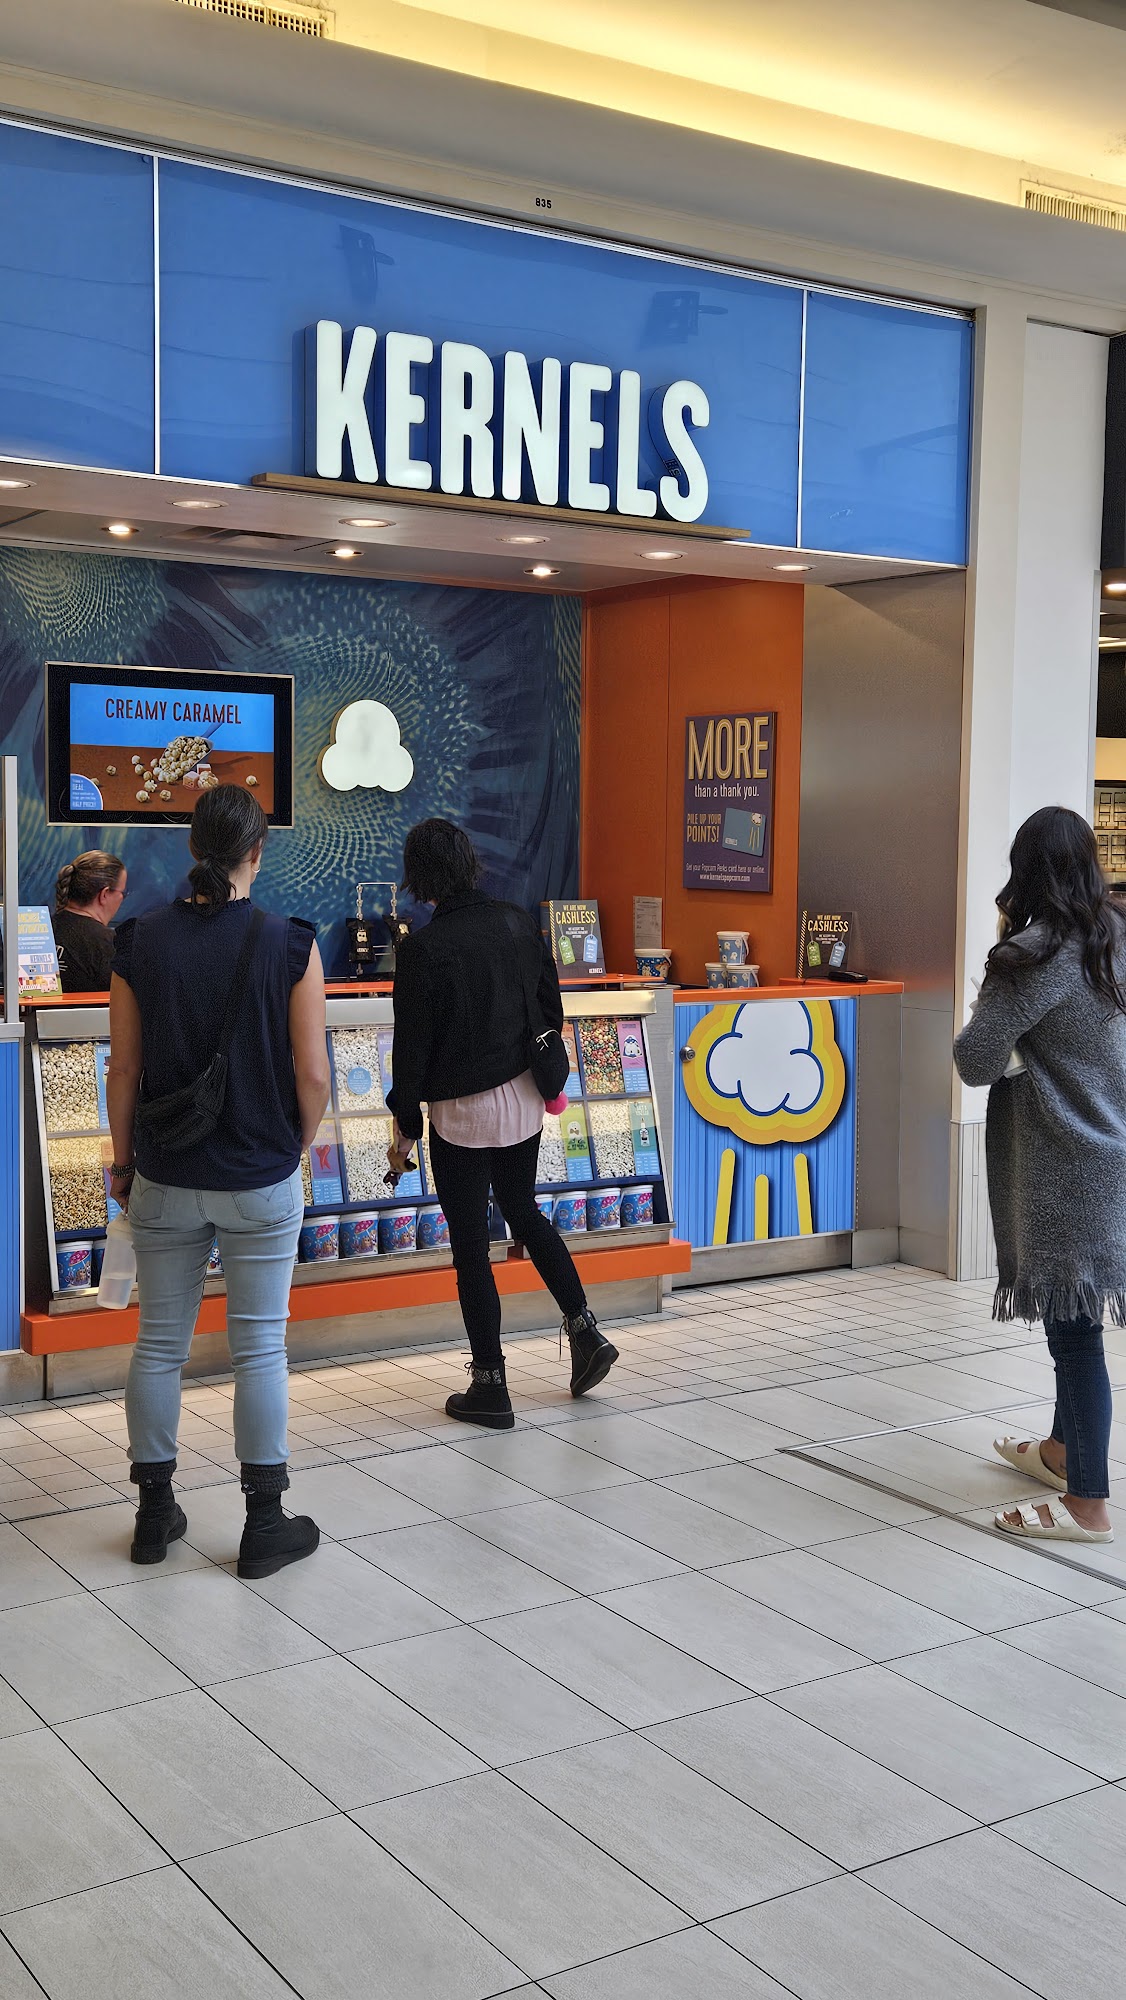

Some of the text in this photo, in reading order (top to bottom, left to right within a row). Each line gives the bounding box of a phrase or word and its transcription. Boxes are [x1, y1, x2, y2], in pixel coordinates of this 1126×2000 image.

[535, 197, 552, 209] 835
[316, 319, 710, 523] KERNELS
[105, 698, 242, 725] CREAMY CARAMEL
[688, 716, 769, 780] MORE
[694, 783, 759, 800] than a thank you.
[687, 813, 721, 825] PILE UP YOUR
[687, 826, 719, 842] POINTS!
[701, 863, 717, 873] Popcorn
[717, 864, 727, 872] Perks
[728, 864, 737, 873] card
[738, 865, 746, 873] here
[556, 911, 596, 924] CASHLESS
[808, 920, 848, 932] CASHLESS
[30, 954, 52, 964] KERNELS
